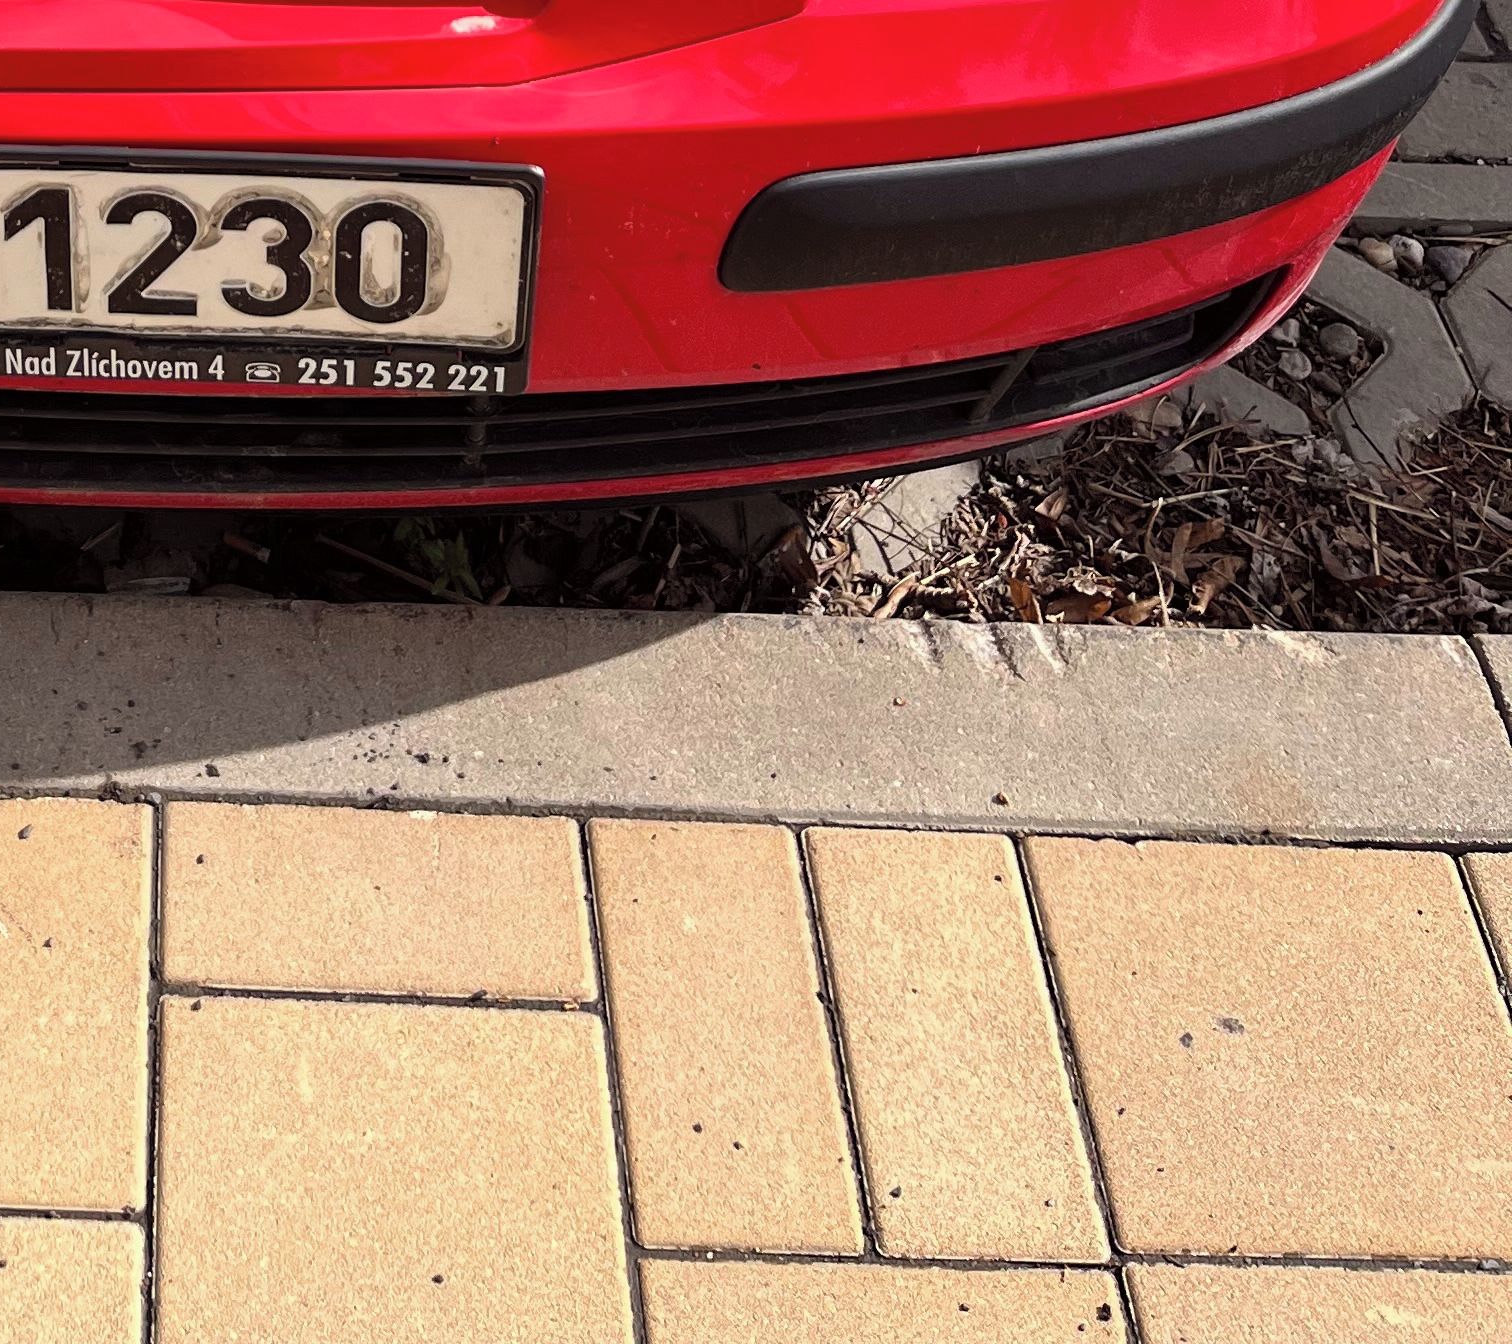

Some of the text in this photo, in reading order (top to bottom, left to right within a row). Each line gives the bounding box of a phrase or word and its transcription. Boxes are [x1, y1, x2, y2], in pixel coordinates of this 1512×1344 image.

[3, 188, 428, 323] 1230
[4, 347, 57, 376] Nad
[65, 349, 199, 380] Zlíchovem
[208, 354, 225, 381] 4
[297, 358, 355, 385] 251
[373, 361, 436, 389] 552
[448, 365, 505, 392] 221
